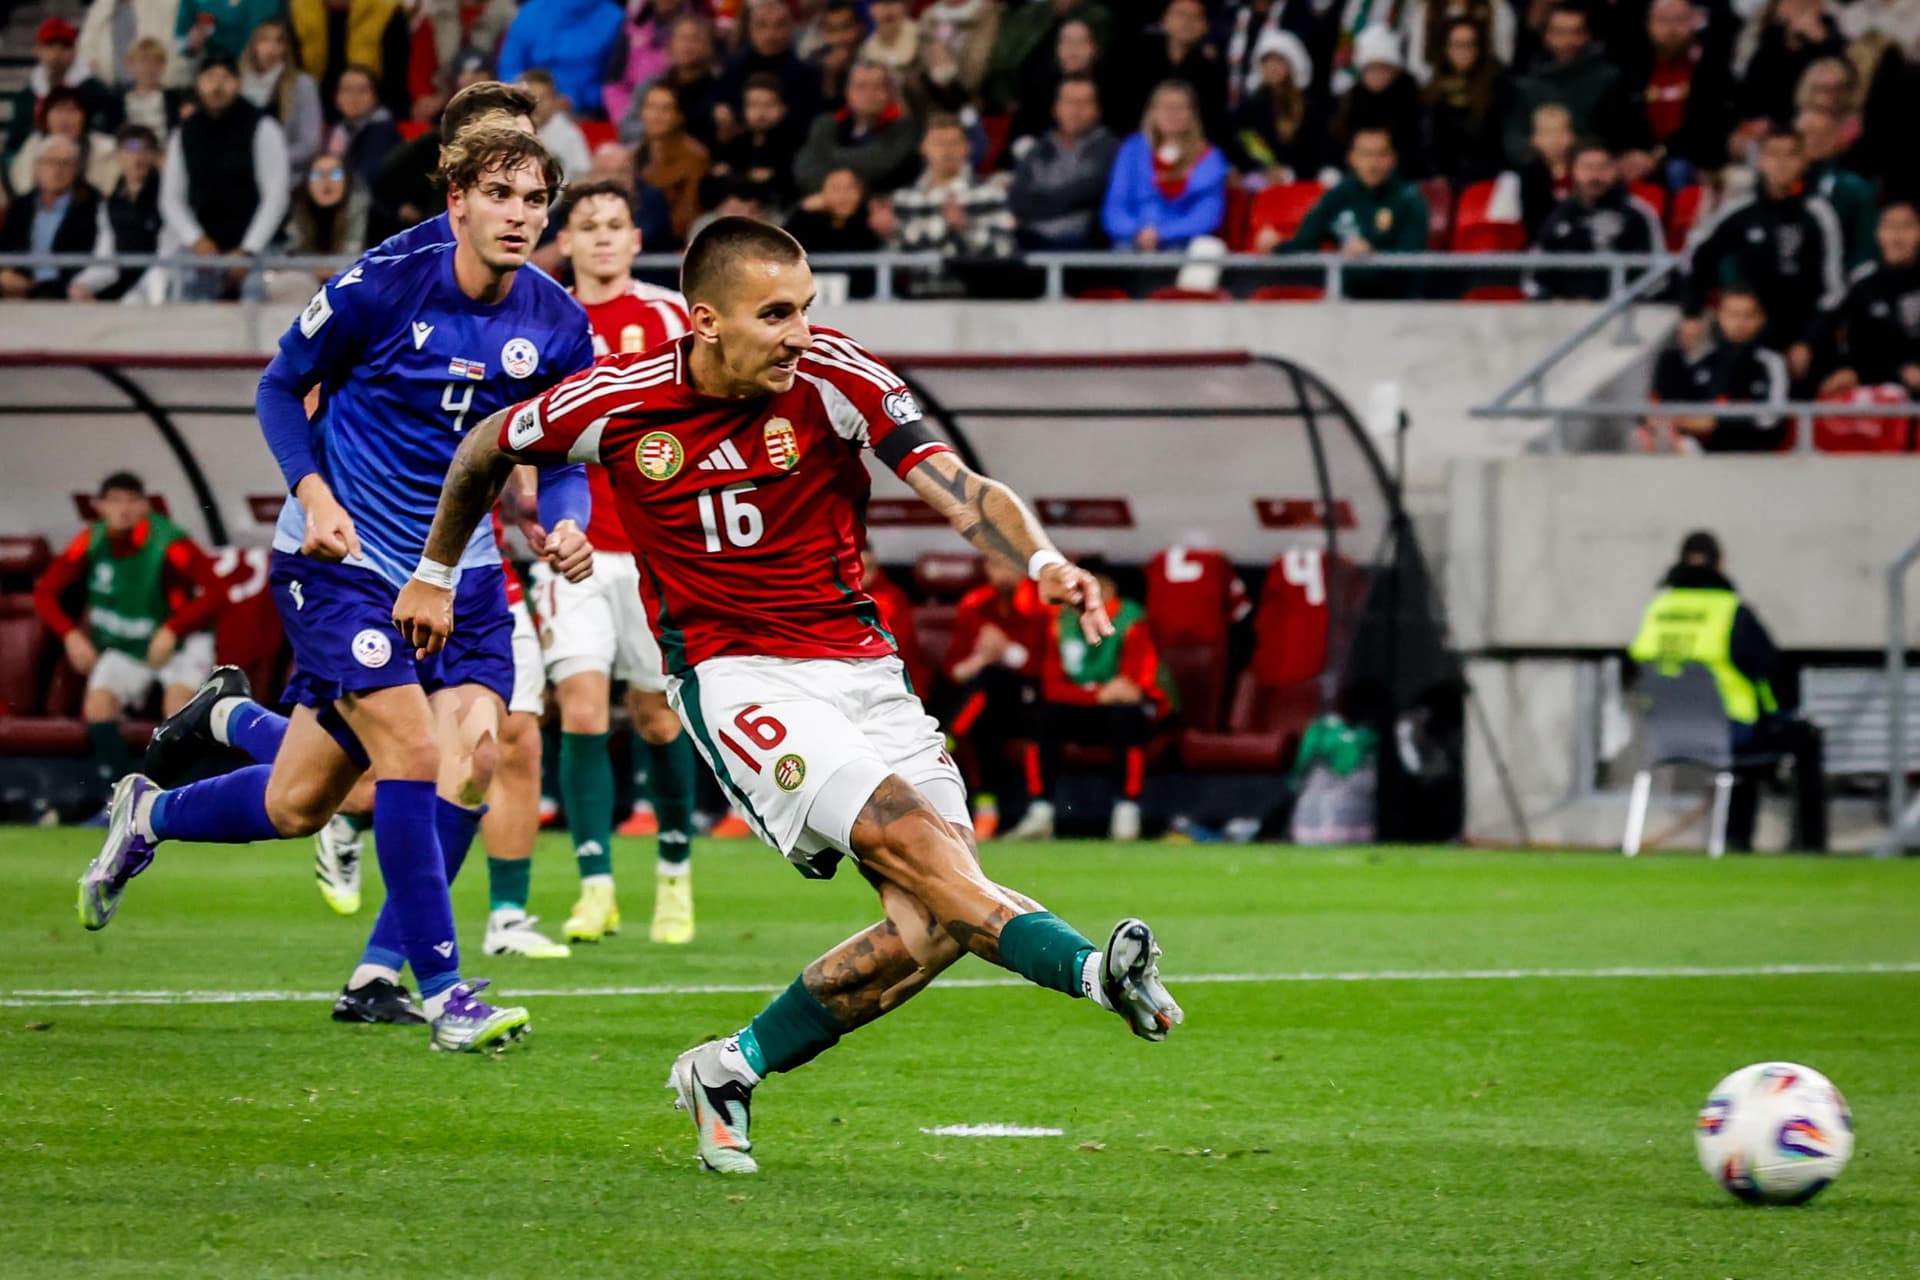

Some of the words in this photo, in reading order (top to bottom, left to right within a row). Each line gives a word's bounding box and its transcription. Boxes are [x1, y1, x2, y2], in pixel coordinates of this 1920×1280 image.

[441, 382, 475, 431] 4
[697, 480, 764, 553] 16
[718, 704, 788, 776] 16
